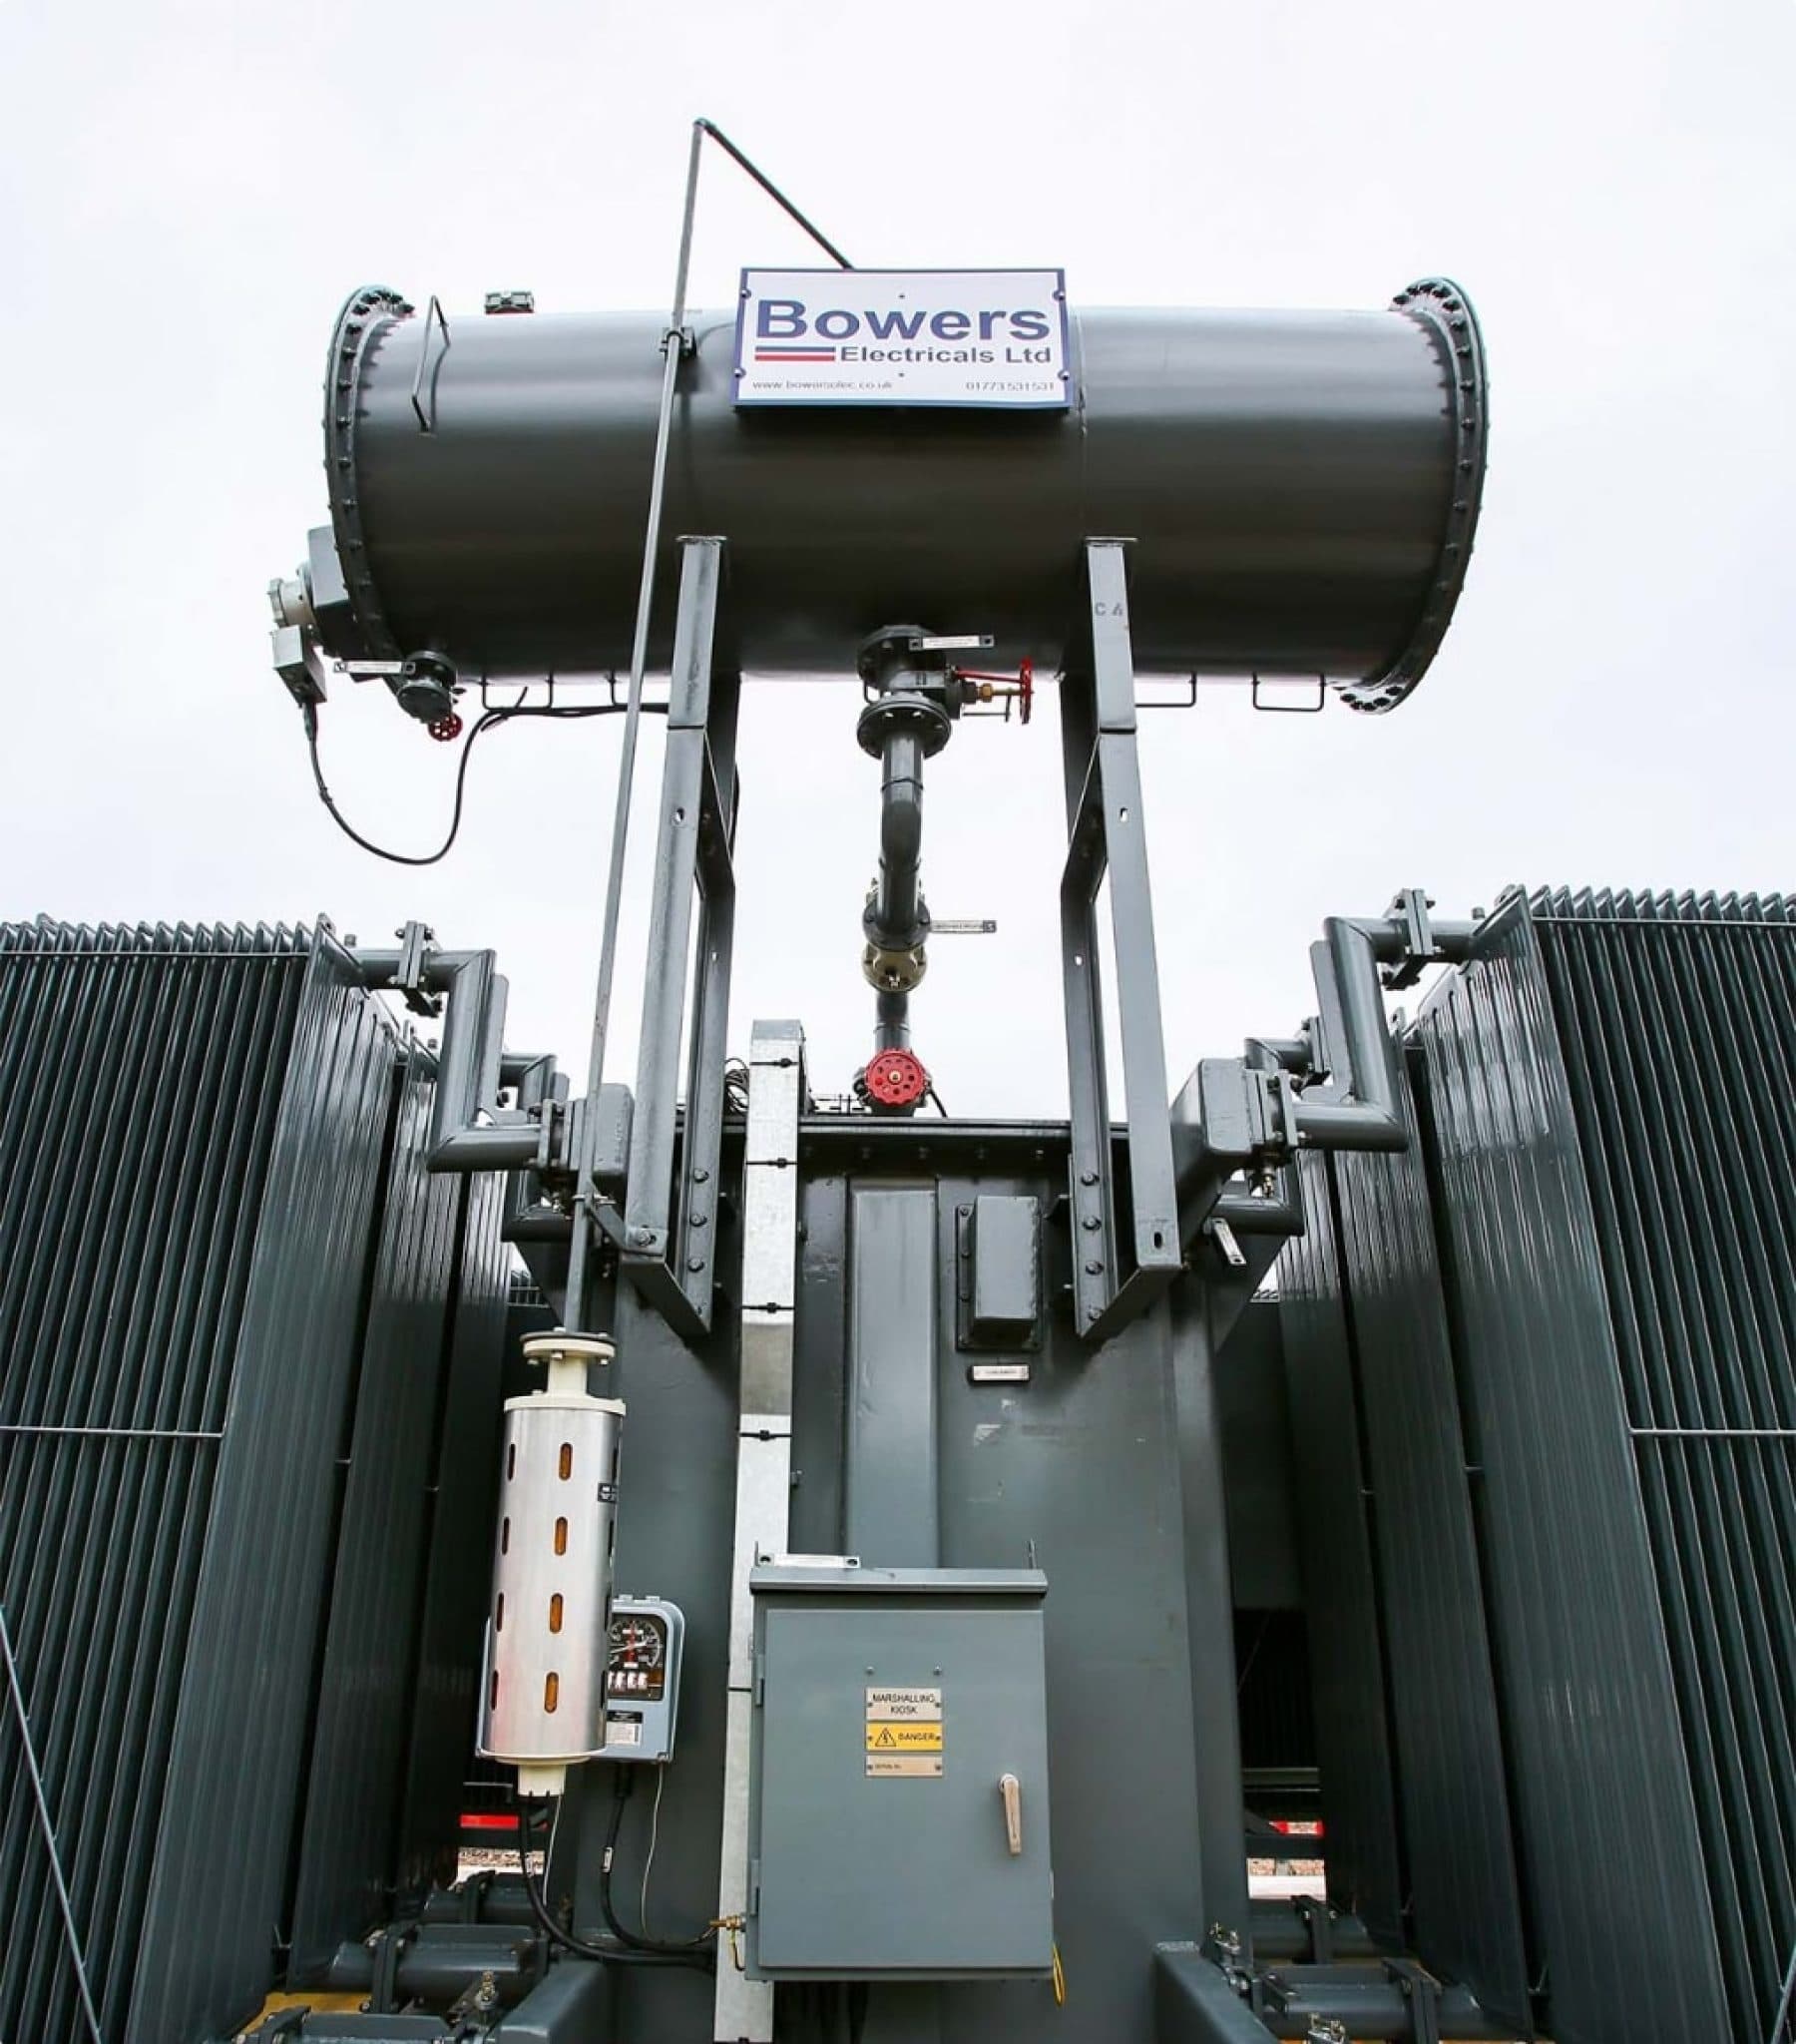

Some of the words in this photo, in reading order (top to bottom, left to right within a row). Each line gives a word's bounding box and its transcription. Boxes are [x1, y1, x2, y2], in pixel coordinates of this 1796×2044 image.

[756, 299, 1050, 340] Bowers
[841, 346, 995, 363] Electricals
[1006, 346, 1052, 363] Ltd
[872, 1694, 935, 1703] MARSHALLING
[890, 1706, 918, 1715] KIOSK
